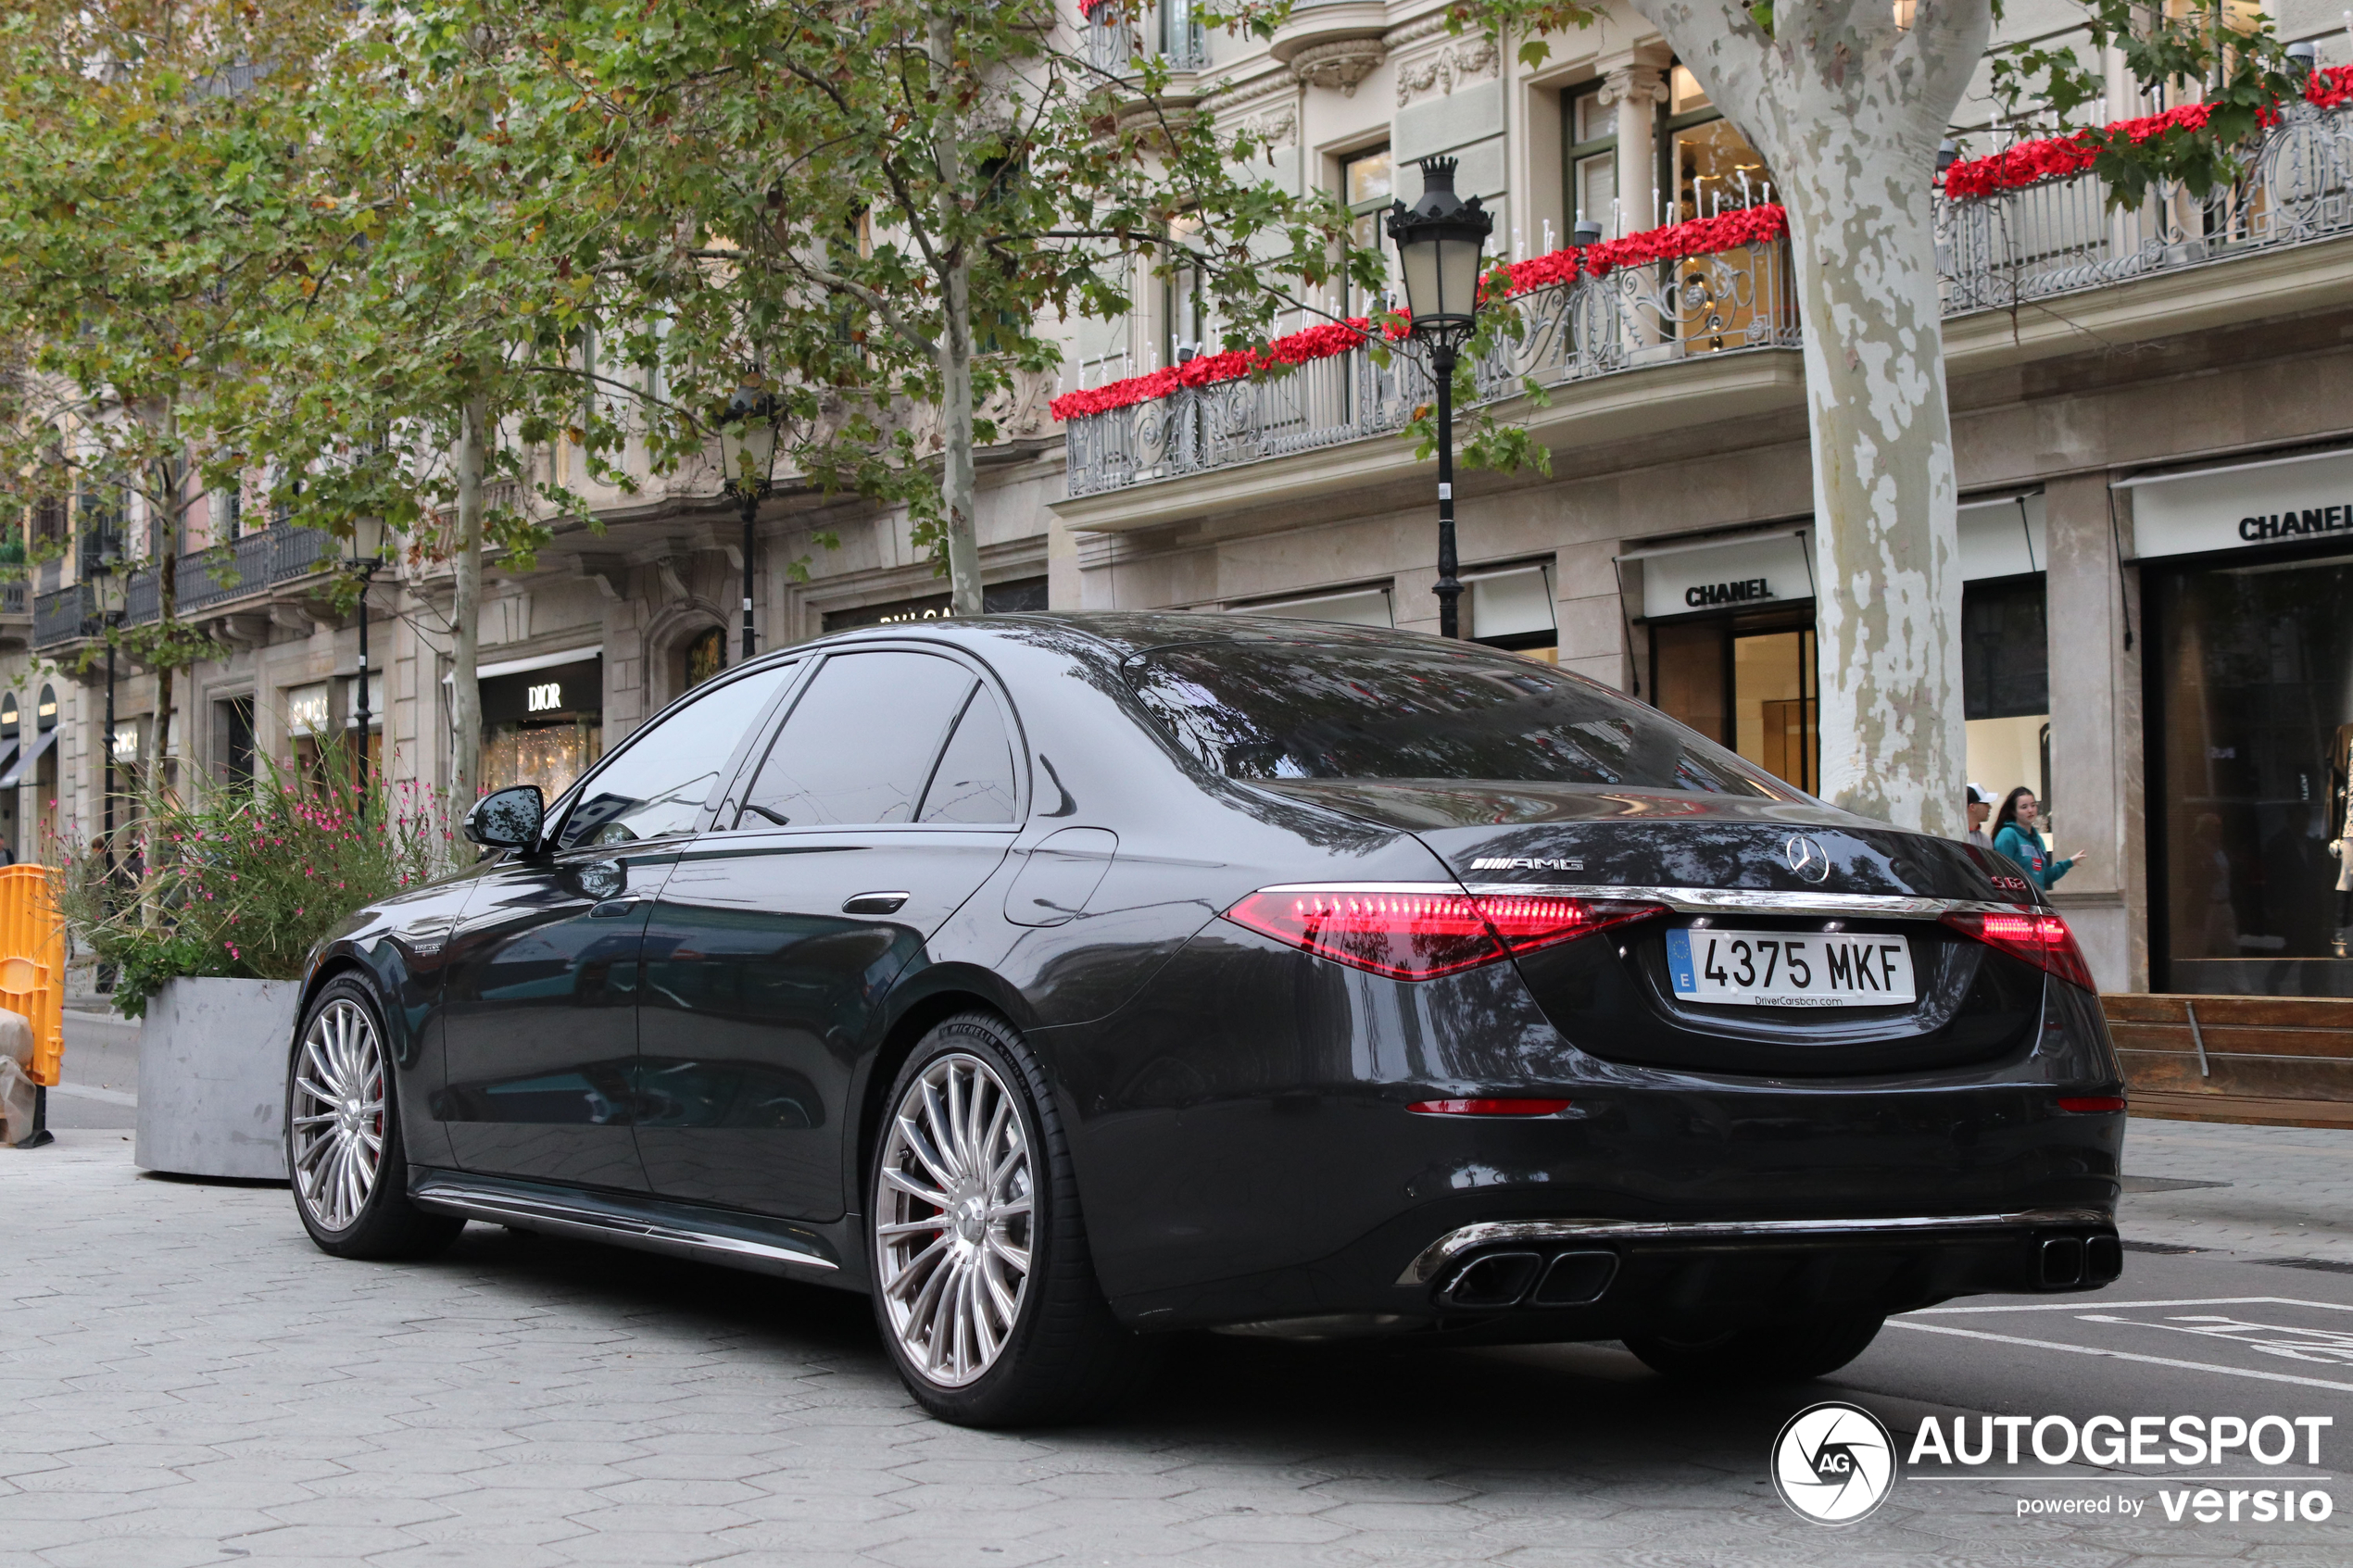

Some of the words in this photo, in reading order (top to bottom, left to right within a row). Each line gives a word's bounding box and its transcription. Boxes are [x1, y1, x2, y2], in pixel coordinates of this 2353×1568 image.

[1685, 578, 1773, 607] CHANEL
[528, 683, 561, 711] DIOR
[1506, 858, 1584, 871] AMG
[1705, 938, 1811, 988] 4375
[1825, 943, 1901, 992] MKF
[1680, 973, 1691, 987] E
[1755, 996, 1843, 1006] DriverCarsbcn.com
[950, 1023, 998, 1047] MICHELIN
